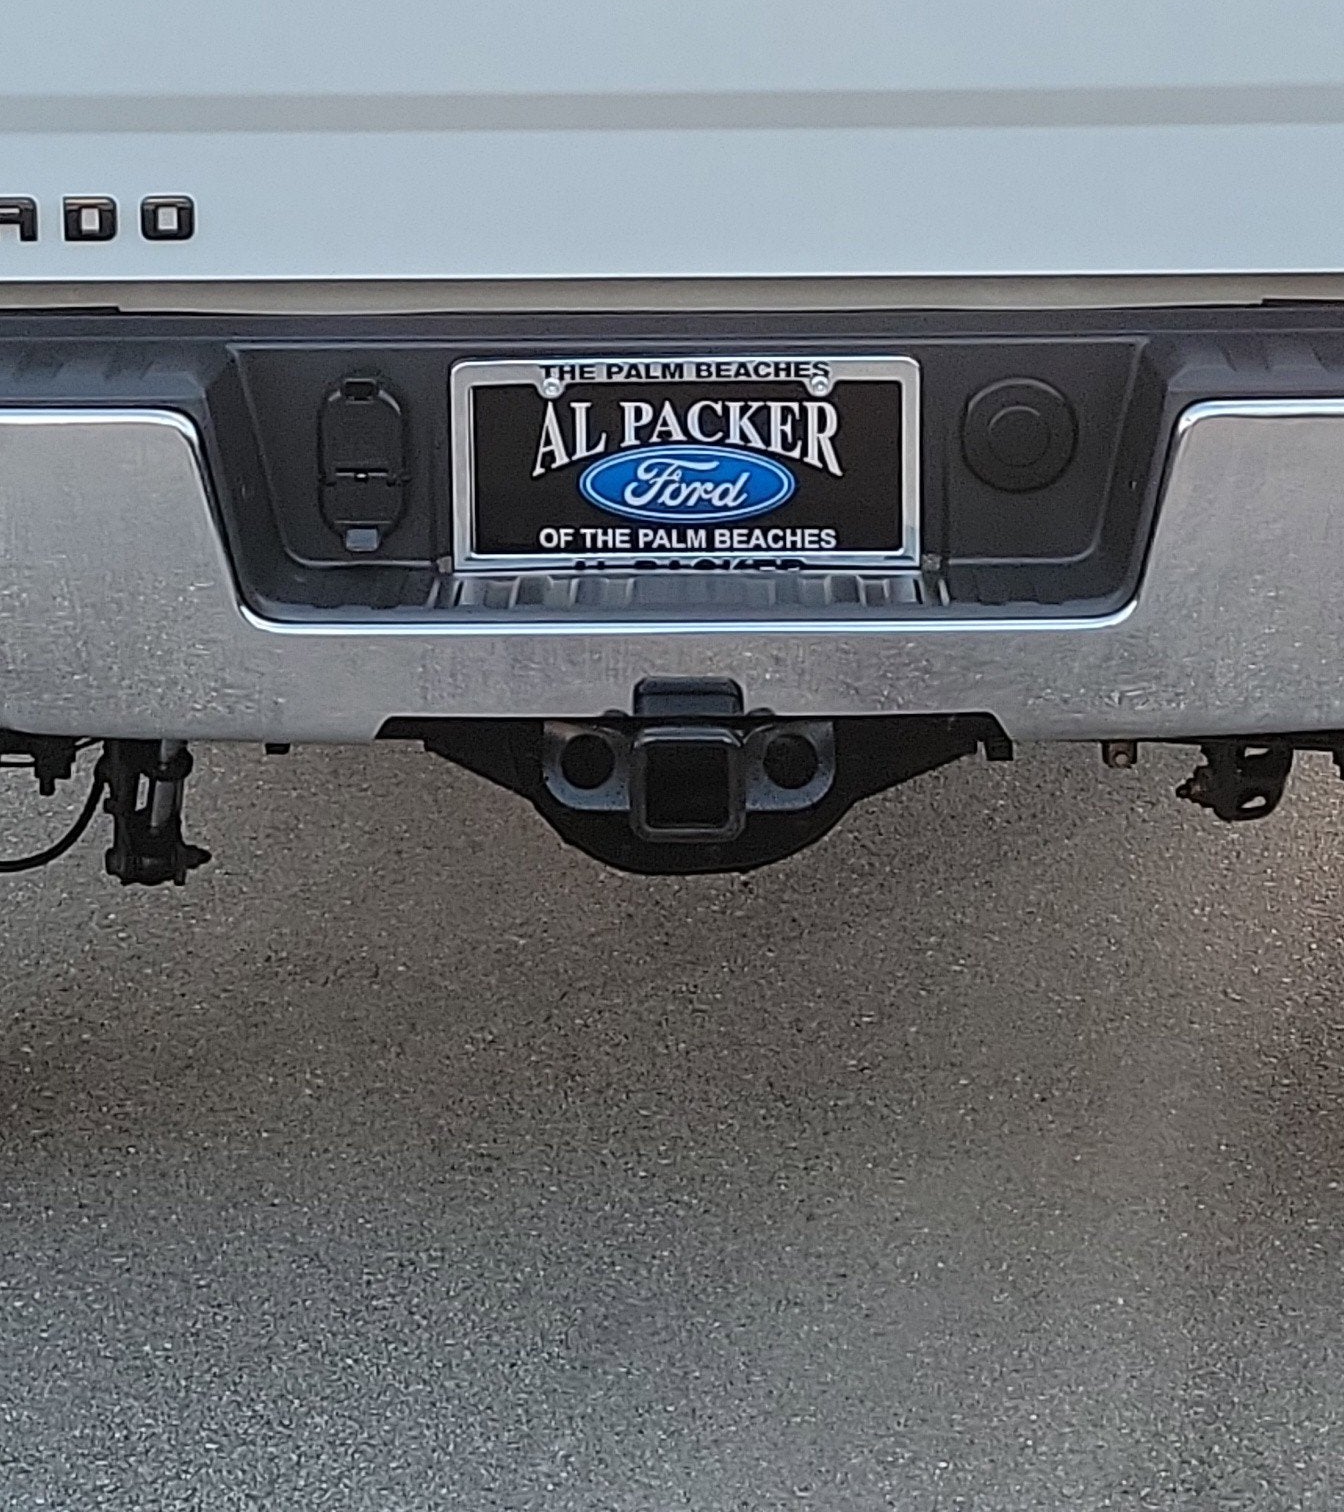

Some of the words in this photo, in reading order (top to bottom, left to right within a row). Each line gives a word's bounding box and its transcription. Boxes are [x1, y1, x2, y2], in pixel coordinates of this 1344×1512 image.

[539, 363, 596, 381] THE
[606, 362, 684, 380] PALM
[695, 361, 831, 379] BEACHES
[531, 400, 607, 477] AL
[619, 400, 844, 477] PACKER
[623, 458, 750, 507] Ford
[539, 528, 574, 549] OF
[580, 528, 632, 549] THE
[638, 528, 706, 549] PALM
[713, 528, 838, 549] BEACHES
